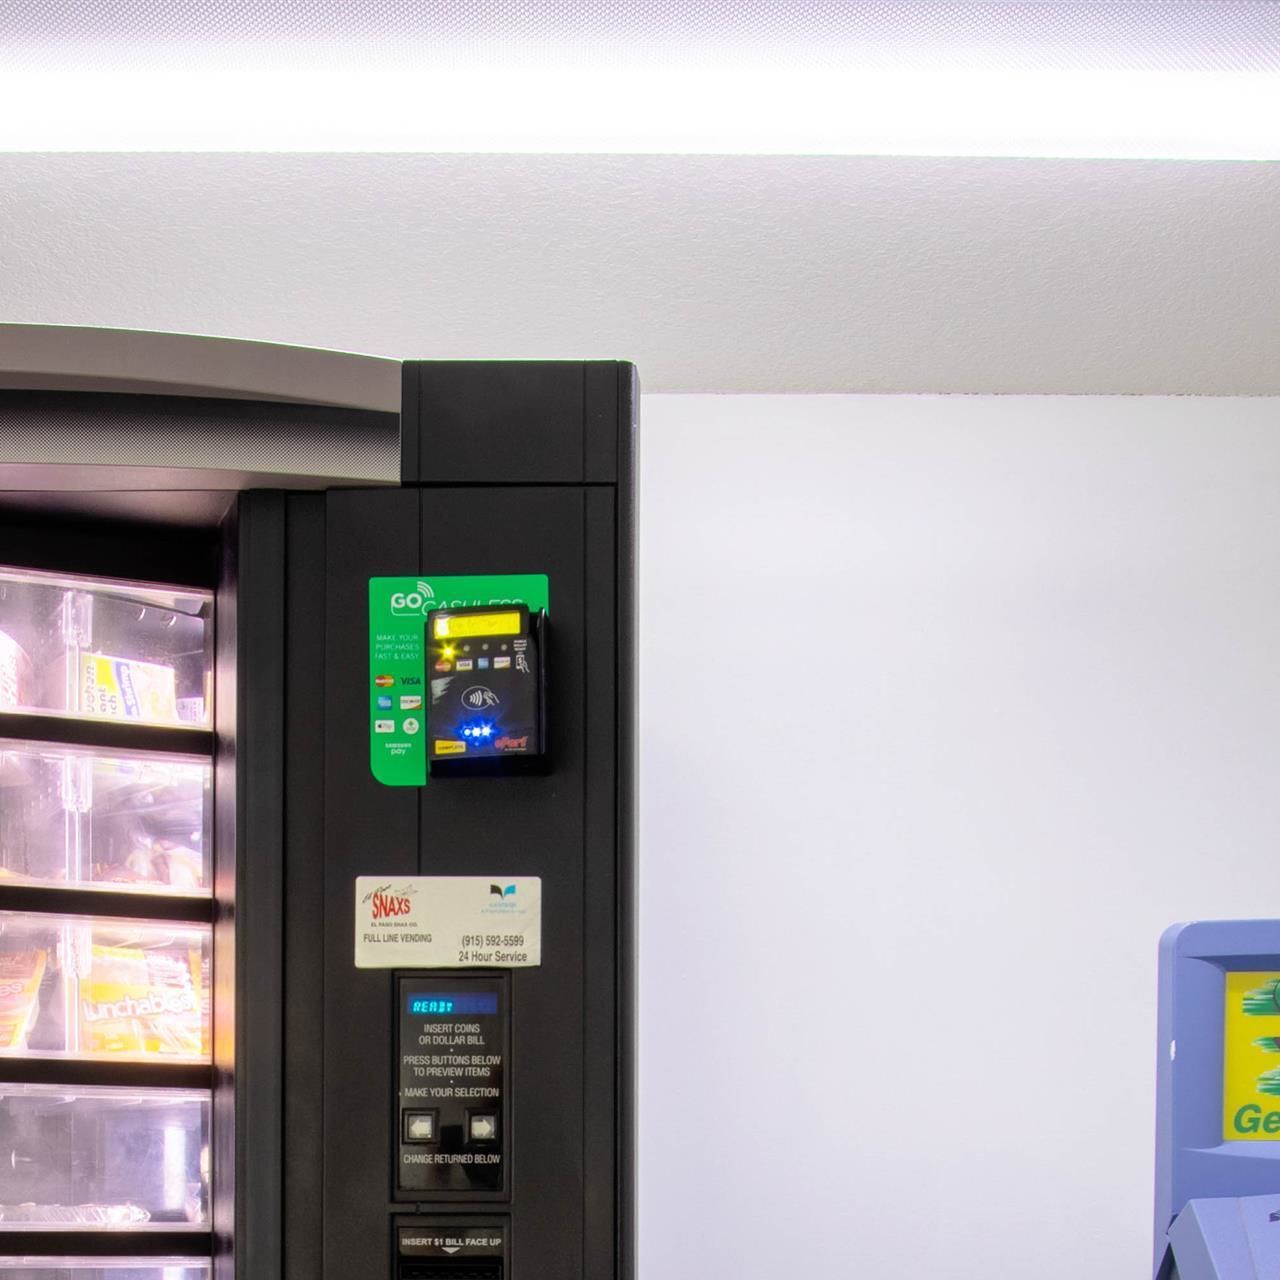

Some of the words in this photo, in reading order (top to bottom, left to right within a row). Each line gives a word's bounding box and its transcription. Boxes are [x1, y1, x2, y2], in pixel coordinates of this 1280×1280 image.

[391, 593, 422, 608] GO
[401, 677, 421, 685] VISA
[372, 892, 410, 920] SNAXS
[364, 933, 382, 944] FULL
[384, 933, 399, 944] LINE
[401, 933, 432, 944] VENDING
[462, 935, 483, 948] (915)
[458, 951, 469, 962] 24
[471, 951, 492, 962] Hour
[494, 951, 527, 962] Service
[424, 1024, 452, 1033] INSERT
[454, 1024, 480, 1033] COINS
[419, 1036, 431, 1044] OR
[433, 1036, 464, 1044] DOLLAR
[466, 1036, 484, 1044] BILL
[404, 1056, 430, 1065] PRESS
[432, 1056, 470, 1065] BUTTONS
[472, 1056, 501, 1065] BELOW
[414, 1067, 424, 1076] TO
[425, 1067, 463, 1076] PREVIEW
[465, 1067, 490, 1076] ITEMS
[405, 1088, 428, 1097] MAKE
[430, 1088, 453, 1097] YOUR
[455, 1088, 499, 1097] SELECTION
[404, 1154, 434, 1164] CHANGE
[436, 1154, 473, 1164] RETURNED
[475, 1154, 500, 1164] BELOW
[402, 1238, 432, 1246] INSERT
[434, 1238, 444, 1246] $1
[446, 1238, 464, 1246] BILL
[466, 1238, 488, 1246] FACE
[490, 1238, 502, 1246] UP
